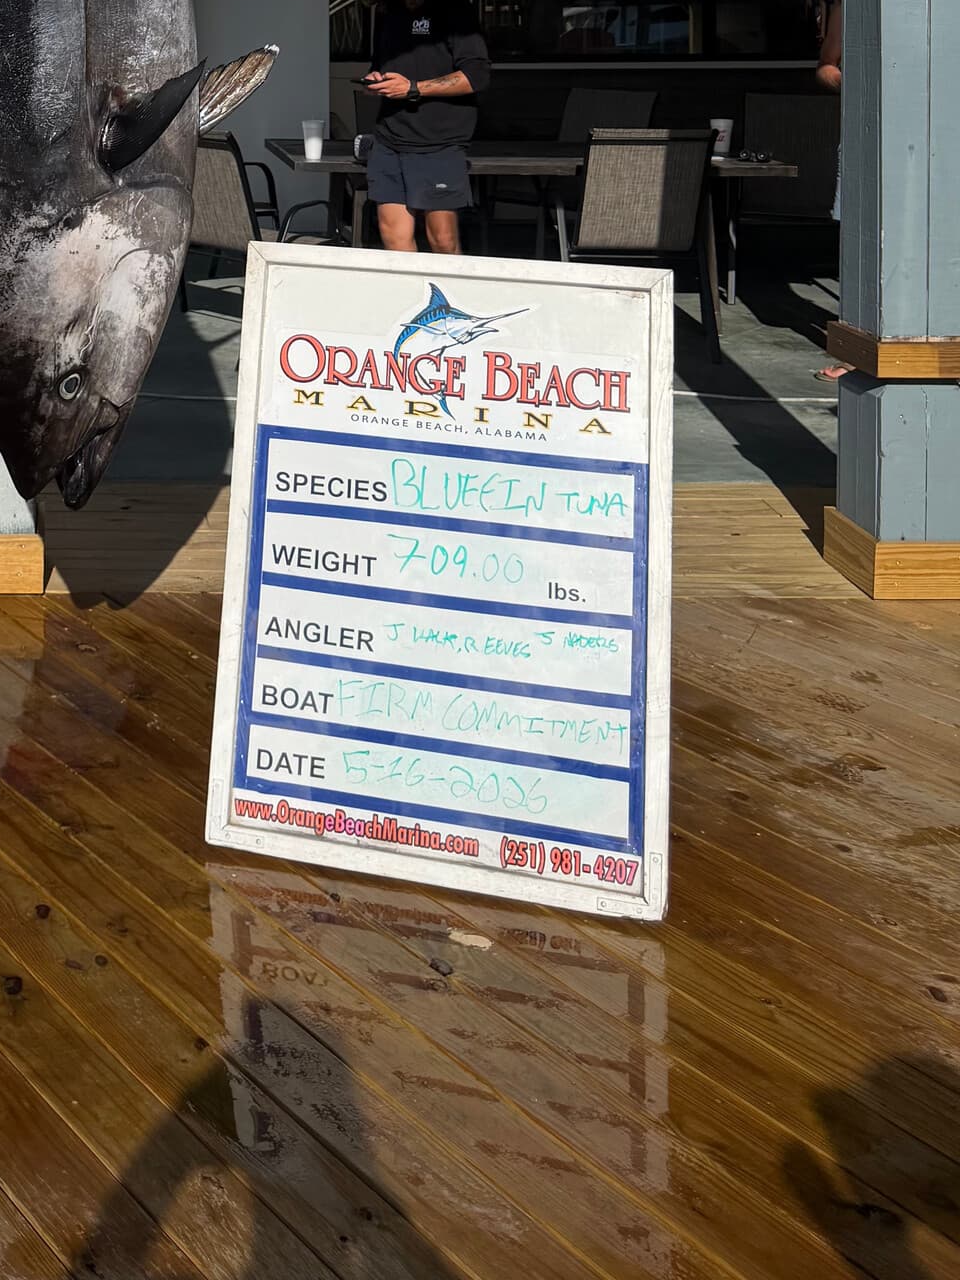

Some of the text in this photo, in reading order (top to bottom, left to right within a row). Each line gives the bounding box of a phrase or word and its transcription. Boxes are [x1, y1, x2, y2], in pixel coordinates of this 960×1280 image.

[280, 334, 631, 413] ORANGE BEACH
[293, 388, 612, 435] MARINA
[350, 413, 547, 441] ORANGE BEACH, ALABAMA
[275, 471, 387, 502] SPECIES
[392, 459, 630, 517] BLUEFIN TUNA
[272, 544, 377, 577] WEIGHT
[387, 533, 524, 583] 709.00
[548, 582, 586, 603] lbs.
[265, 616, 374, 652] ANGLER
[261, 684, 334, 714] BOAT
[337, 679, 628, 754] FIRM COMMITMENT
[256, 748, 326, 779] DATE
[342, 750, 548, 814] 5-16-2026
[235, 798, 639, 886] www.OrangeBeachMarina.com (251) 981-4207
